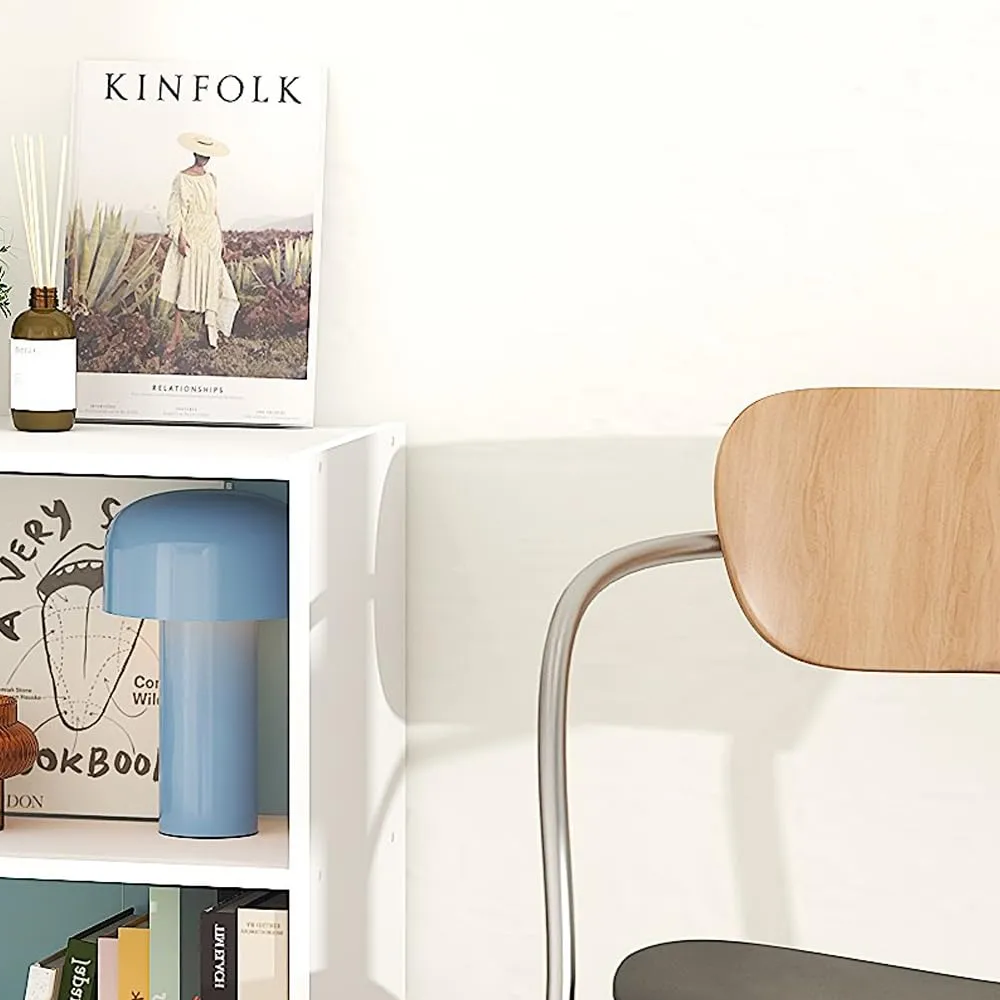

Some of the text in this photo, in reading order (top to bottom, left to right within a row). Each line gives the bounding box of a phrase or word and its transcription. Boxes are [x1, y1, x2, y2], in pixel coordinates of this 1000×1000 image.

[105, 73, 302, 104] KINFOLK
[151, 384, 225, 394] RELATIONSHIPS
[0, 499, 72, 582] VERY
[133, 692, 159, 705] Wil
